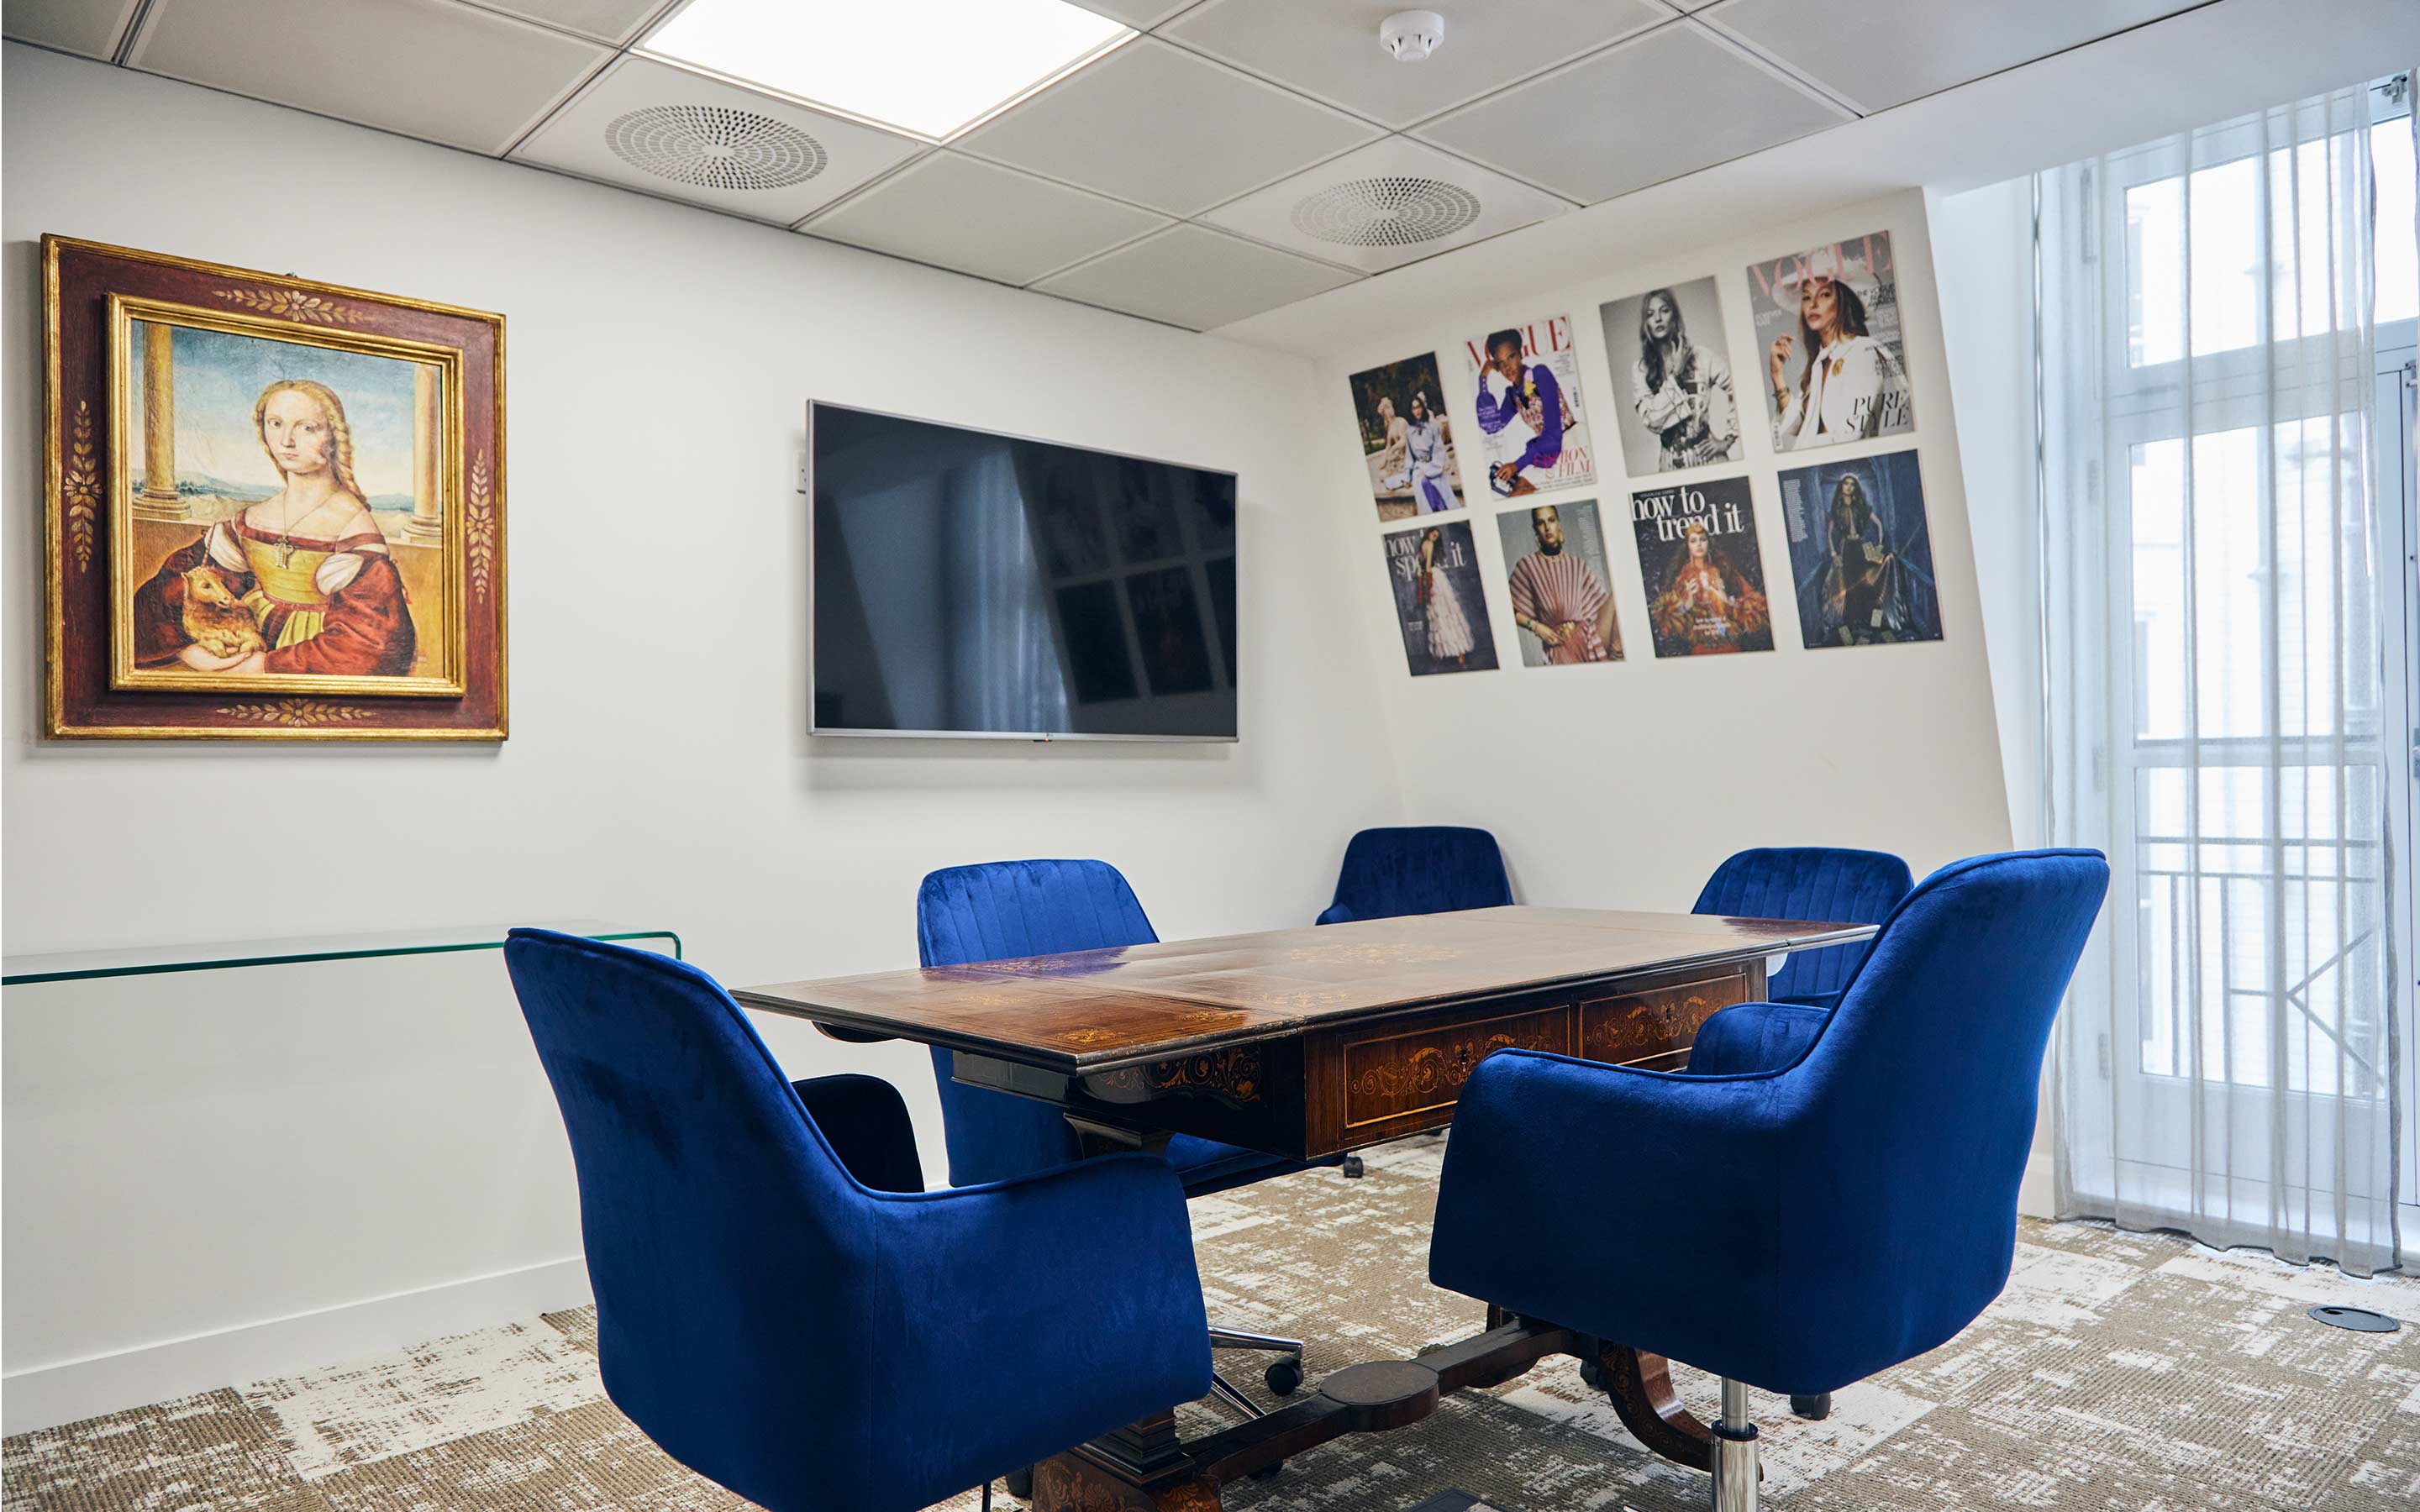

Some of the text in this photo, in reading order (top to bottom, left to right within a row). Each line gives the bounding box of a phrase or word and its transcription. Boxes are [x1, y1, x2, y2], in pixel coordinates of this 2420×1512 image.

[1853, 389, 1909, 416] PURE
[1844, 408, 1909, 434] STYLE
[1679, 486, 1706, 515] to
[1723, 502, 1745, 534] it
